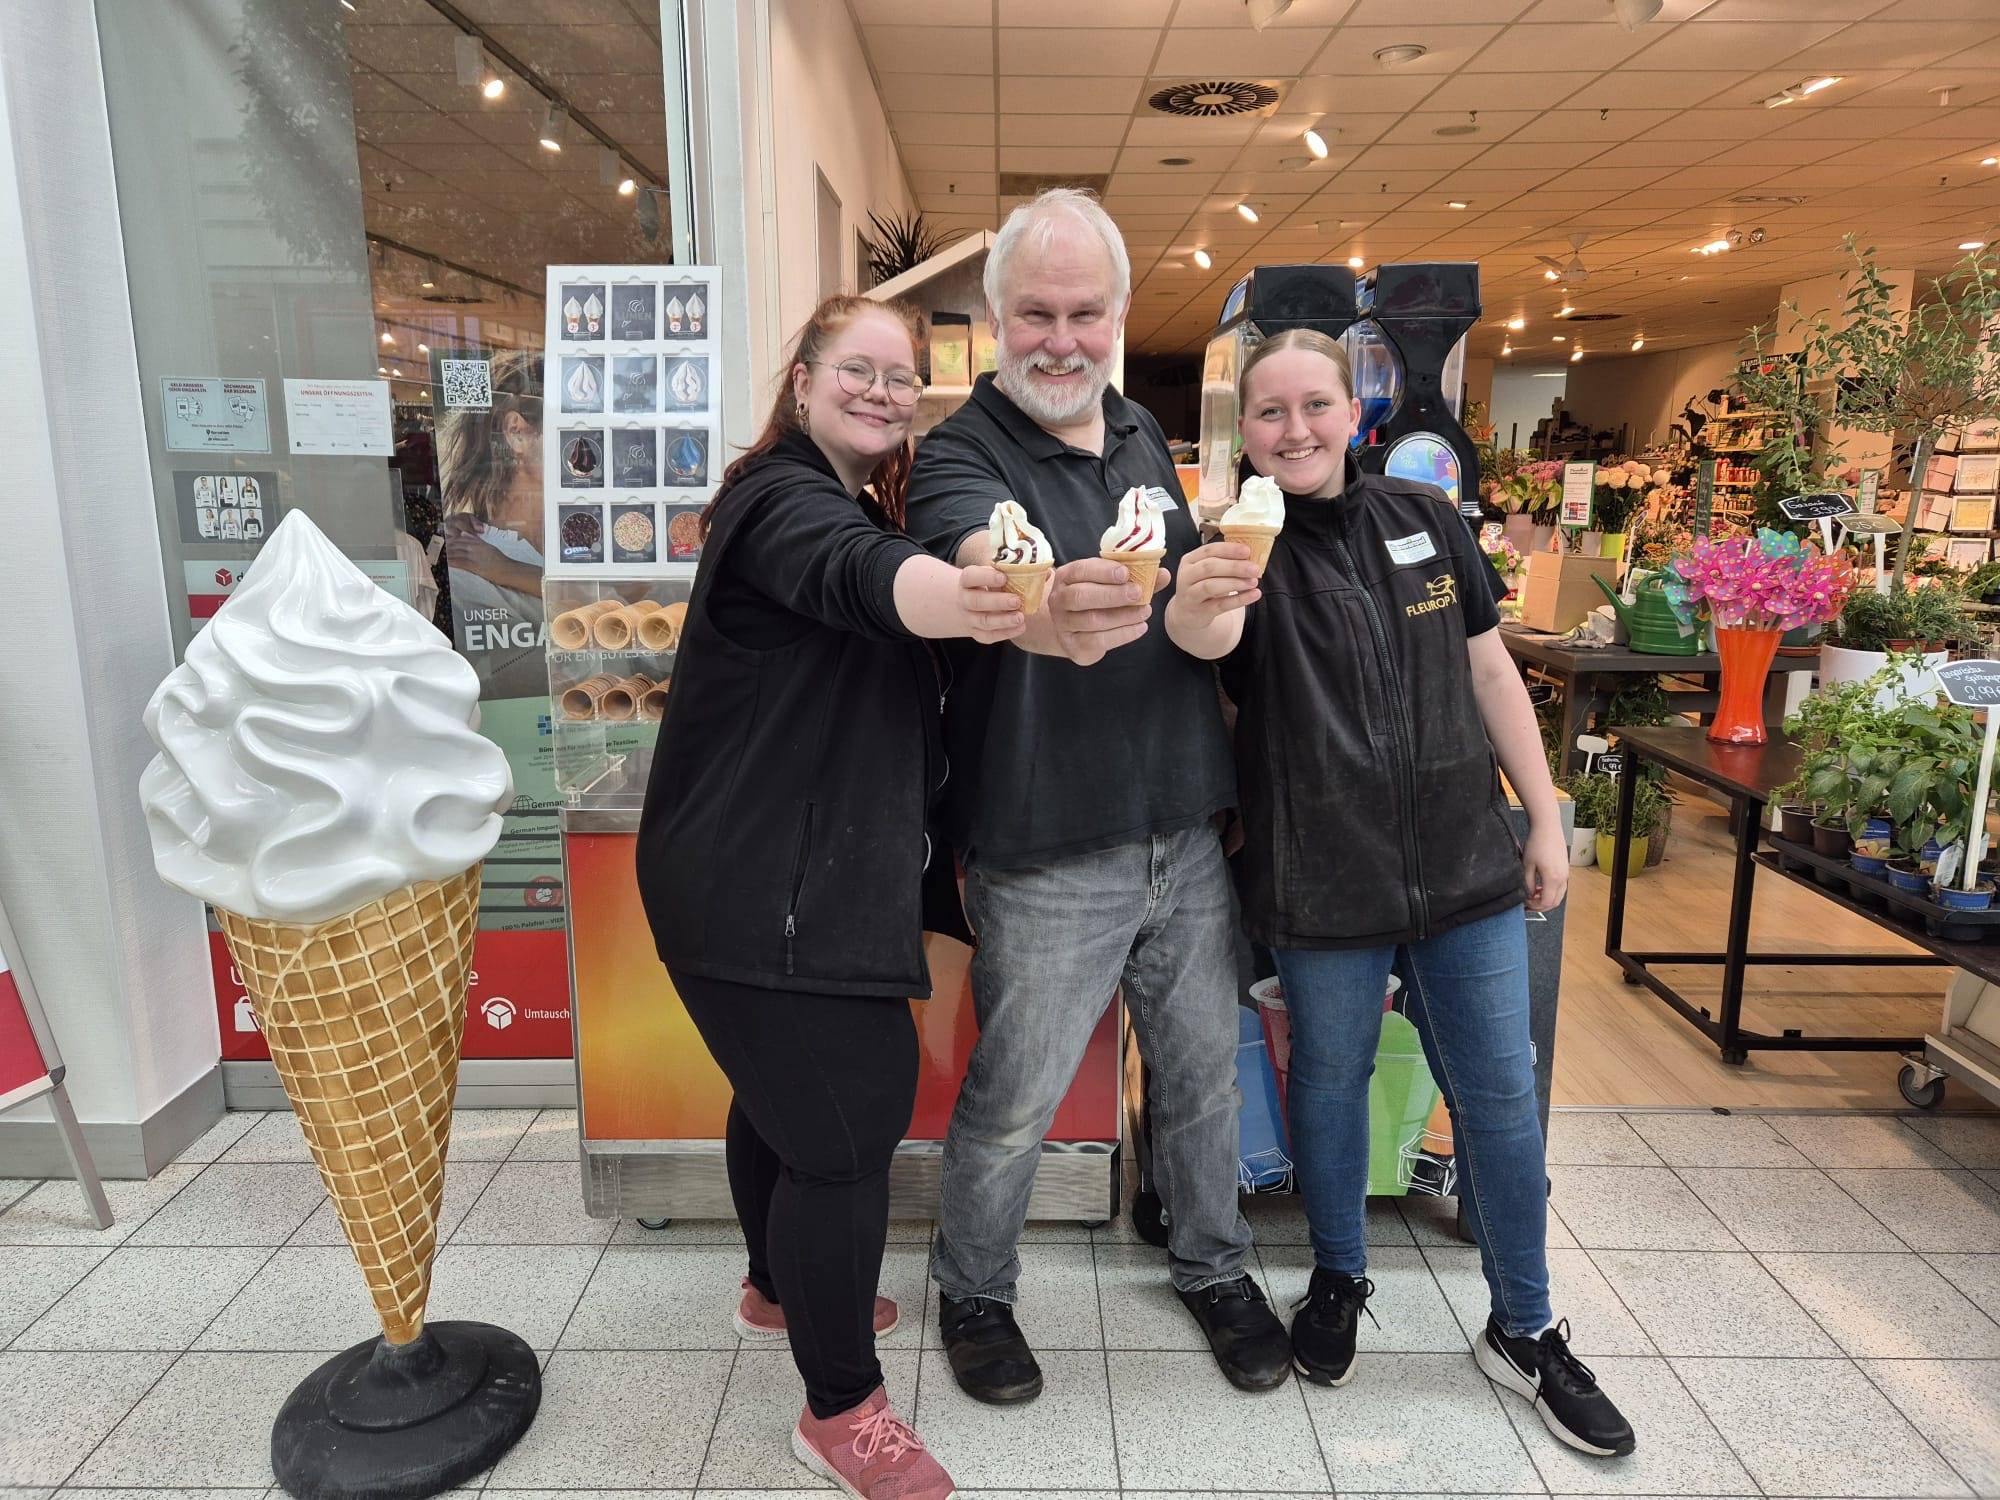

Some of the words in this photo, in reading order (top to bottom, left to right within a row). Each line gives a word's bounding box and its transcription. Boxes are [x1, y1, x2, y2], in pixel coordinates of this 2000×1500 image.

[1406, 595, 1451, 617] FLEUROP
[464, 608, 508, 622] UNSER
[464, 621, 548, 651] ENGA
[531, 799, 565, 809] German
[510, 826, 536, 835] German
[524, 1008, 570, 1020] Umtausch
